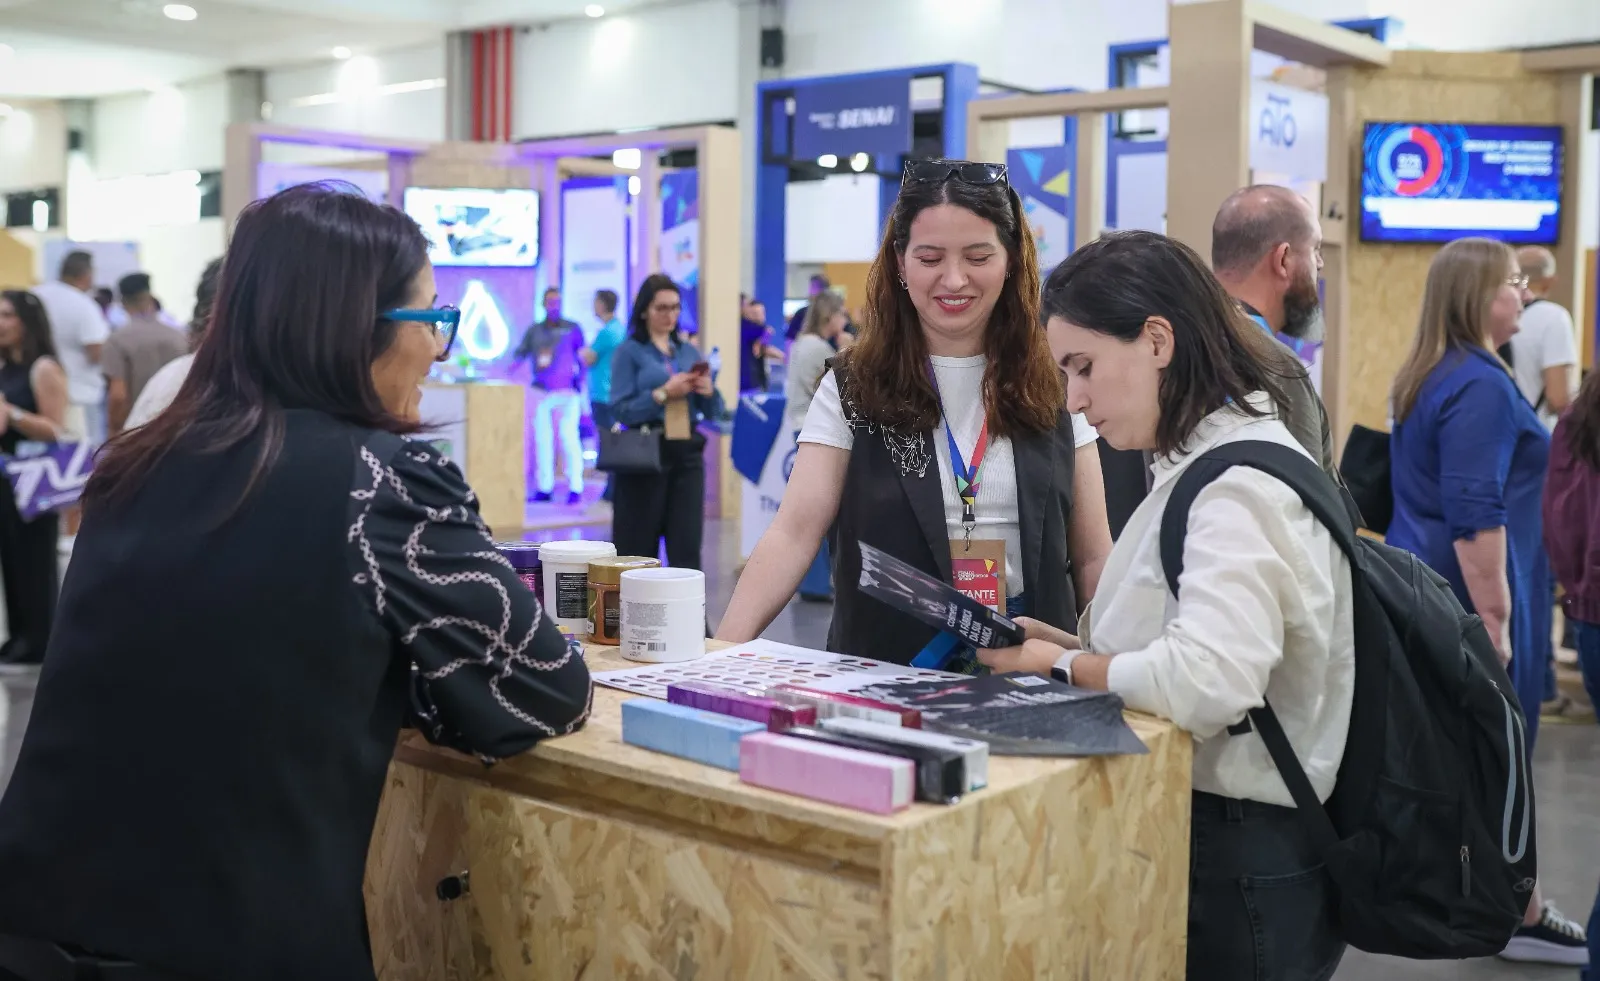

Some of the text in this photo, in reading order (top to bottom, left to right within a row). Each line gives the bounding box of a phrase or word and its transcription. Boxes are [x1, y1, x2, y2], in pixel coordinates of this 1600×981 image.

[837, 105, 895, 129] SENAI
[959, 608, 973, 631] FÁBRICA
[972, 620, 983, 633] SUA
[959, 628, 969, 637] A
[968, 629, 981, 642] DA
[979, 625, 993, 648] MARCA
